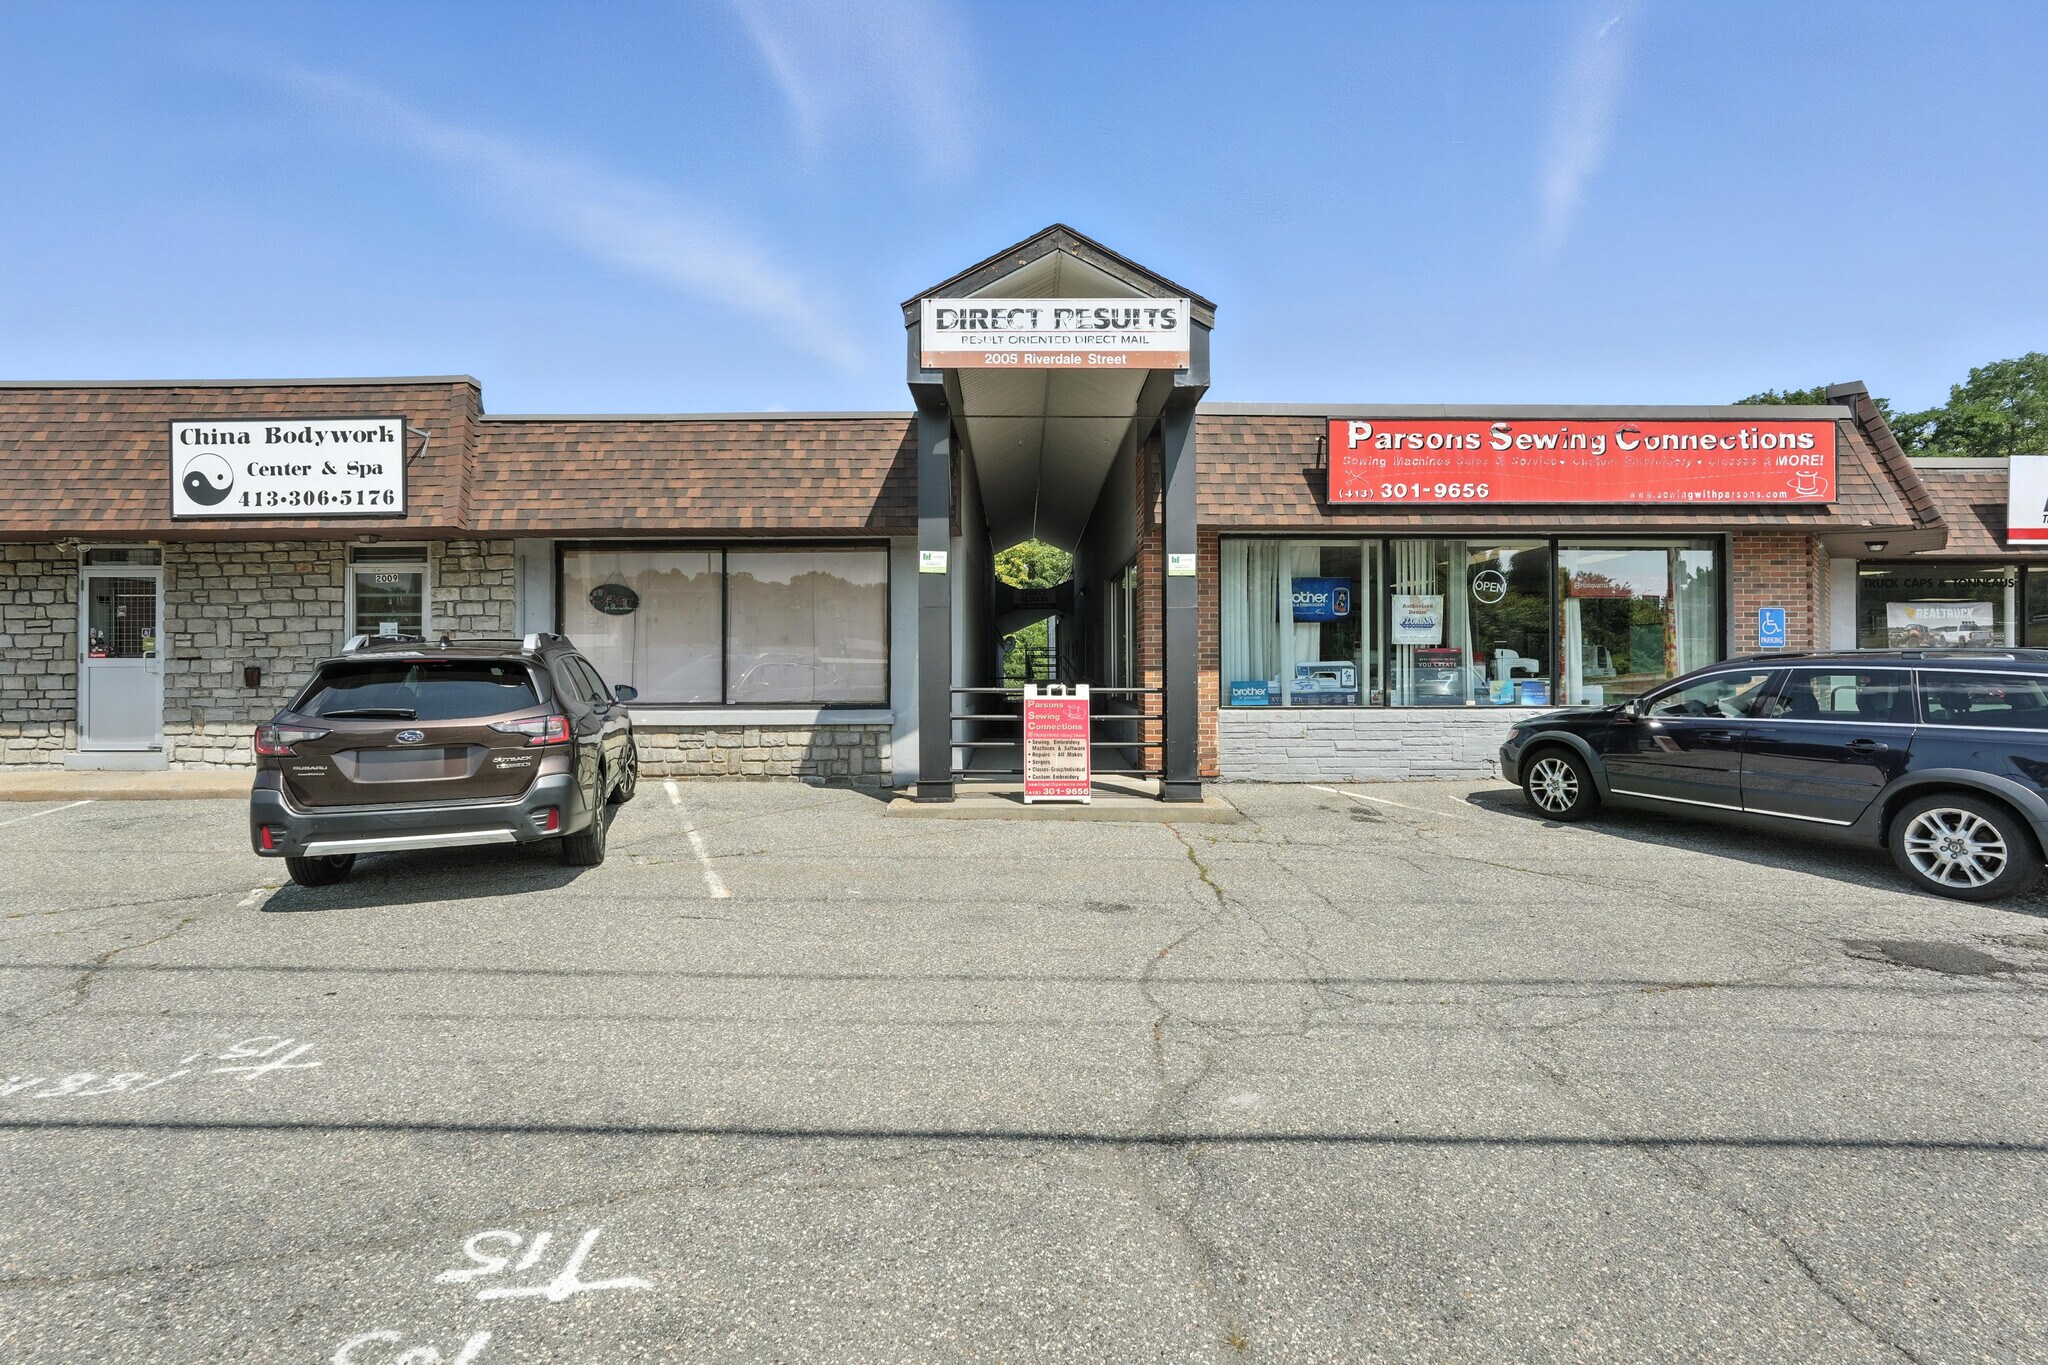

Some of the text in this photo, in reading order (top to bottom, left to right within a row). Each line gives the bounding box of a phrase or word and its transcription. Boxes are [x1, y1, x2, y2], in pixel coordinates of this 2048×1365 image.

[936, 308, 1178, 330] DIRECT RESULTS
[961, 335, 1150, 345] RESULT ORIENTED DIRECT MAIL
[984, 353, 1127, 365] 2005 Riverdale Street
[180, 425, 395, 446] China Bodywork
[1347, 420, 1815, 455] Parsons Sewing Connections
[1343, 456, 1387, 468] Sewing
[1393, 456, 1451, 466] Machines
[1775, 454, 1824, 467] MORE!
[247, 460, 383, 478] Center & Spa
[1339, 483, 1490, 499] (413) 301-9656
[1629, 489, 1788, 500] www.sewingwithparsons.com
[376, 574, 398, 583] 2009
[1863, 578, 2015, 588] TRUCK CAPS & TONNEAUS
[1475, 580, 1504, 593] OPEN
[1292, 591, 1328, 603] other
[1916, 608, 1974, 619] REALTRUCK
[1760, 636, 1784, 644] PARKING
[1232, 687, 1267, 696] brother
[1028, 700, 1064, 708] Parsons
[1028, 711, 1060, 721] Sewing
[1028, 722, 1083, 730] Connections
[492, 755, 532, 763] OUTBACK
